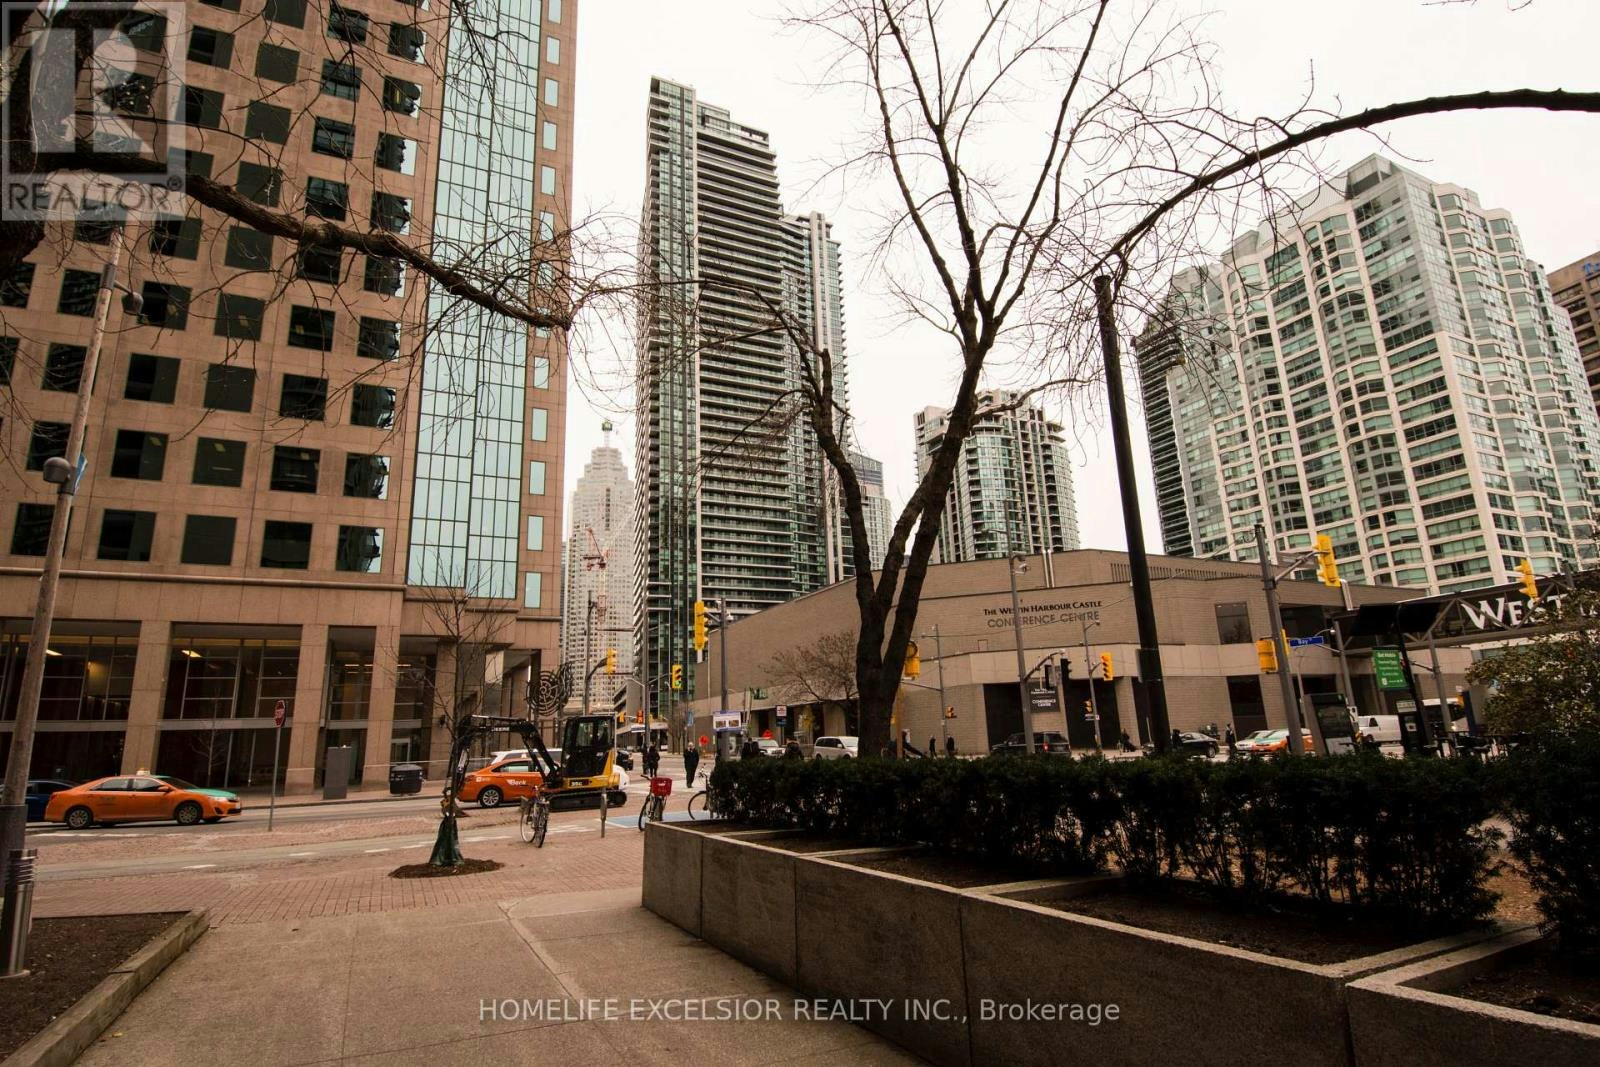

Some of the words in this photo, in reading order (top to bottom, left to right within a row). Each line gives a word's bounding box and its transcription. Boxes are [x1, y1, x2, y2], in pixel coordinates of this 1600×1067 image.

[984, 608, 997, 616] THE
[999, 606, 1029, 616] WETIN
[1031, 603, 1071, 613] HARBOUR
[1072, 600, 1102, 610] CASTLE
[986, 613, 1056, 628] CONERENCE
[1060, 611, 1100, 623] CENTRE
